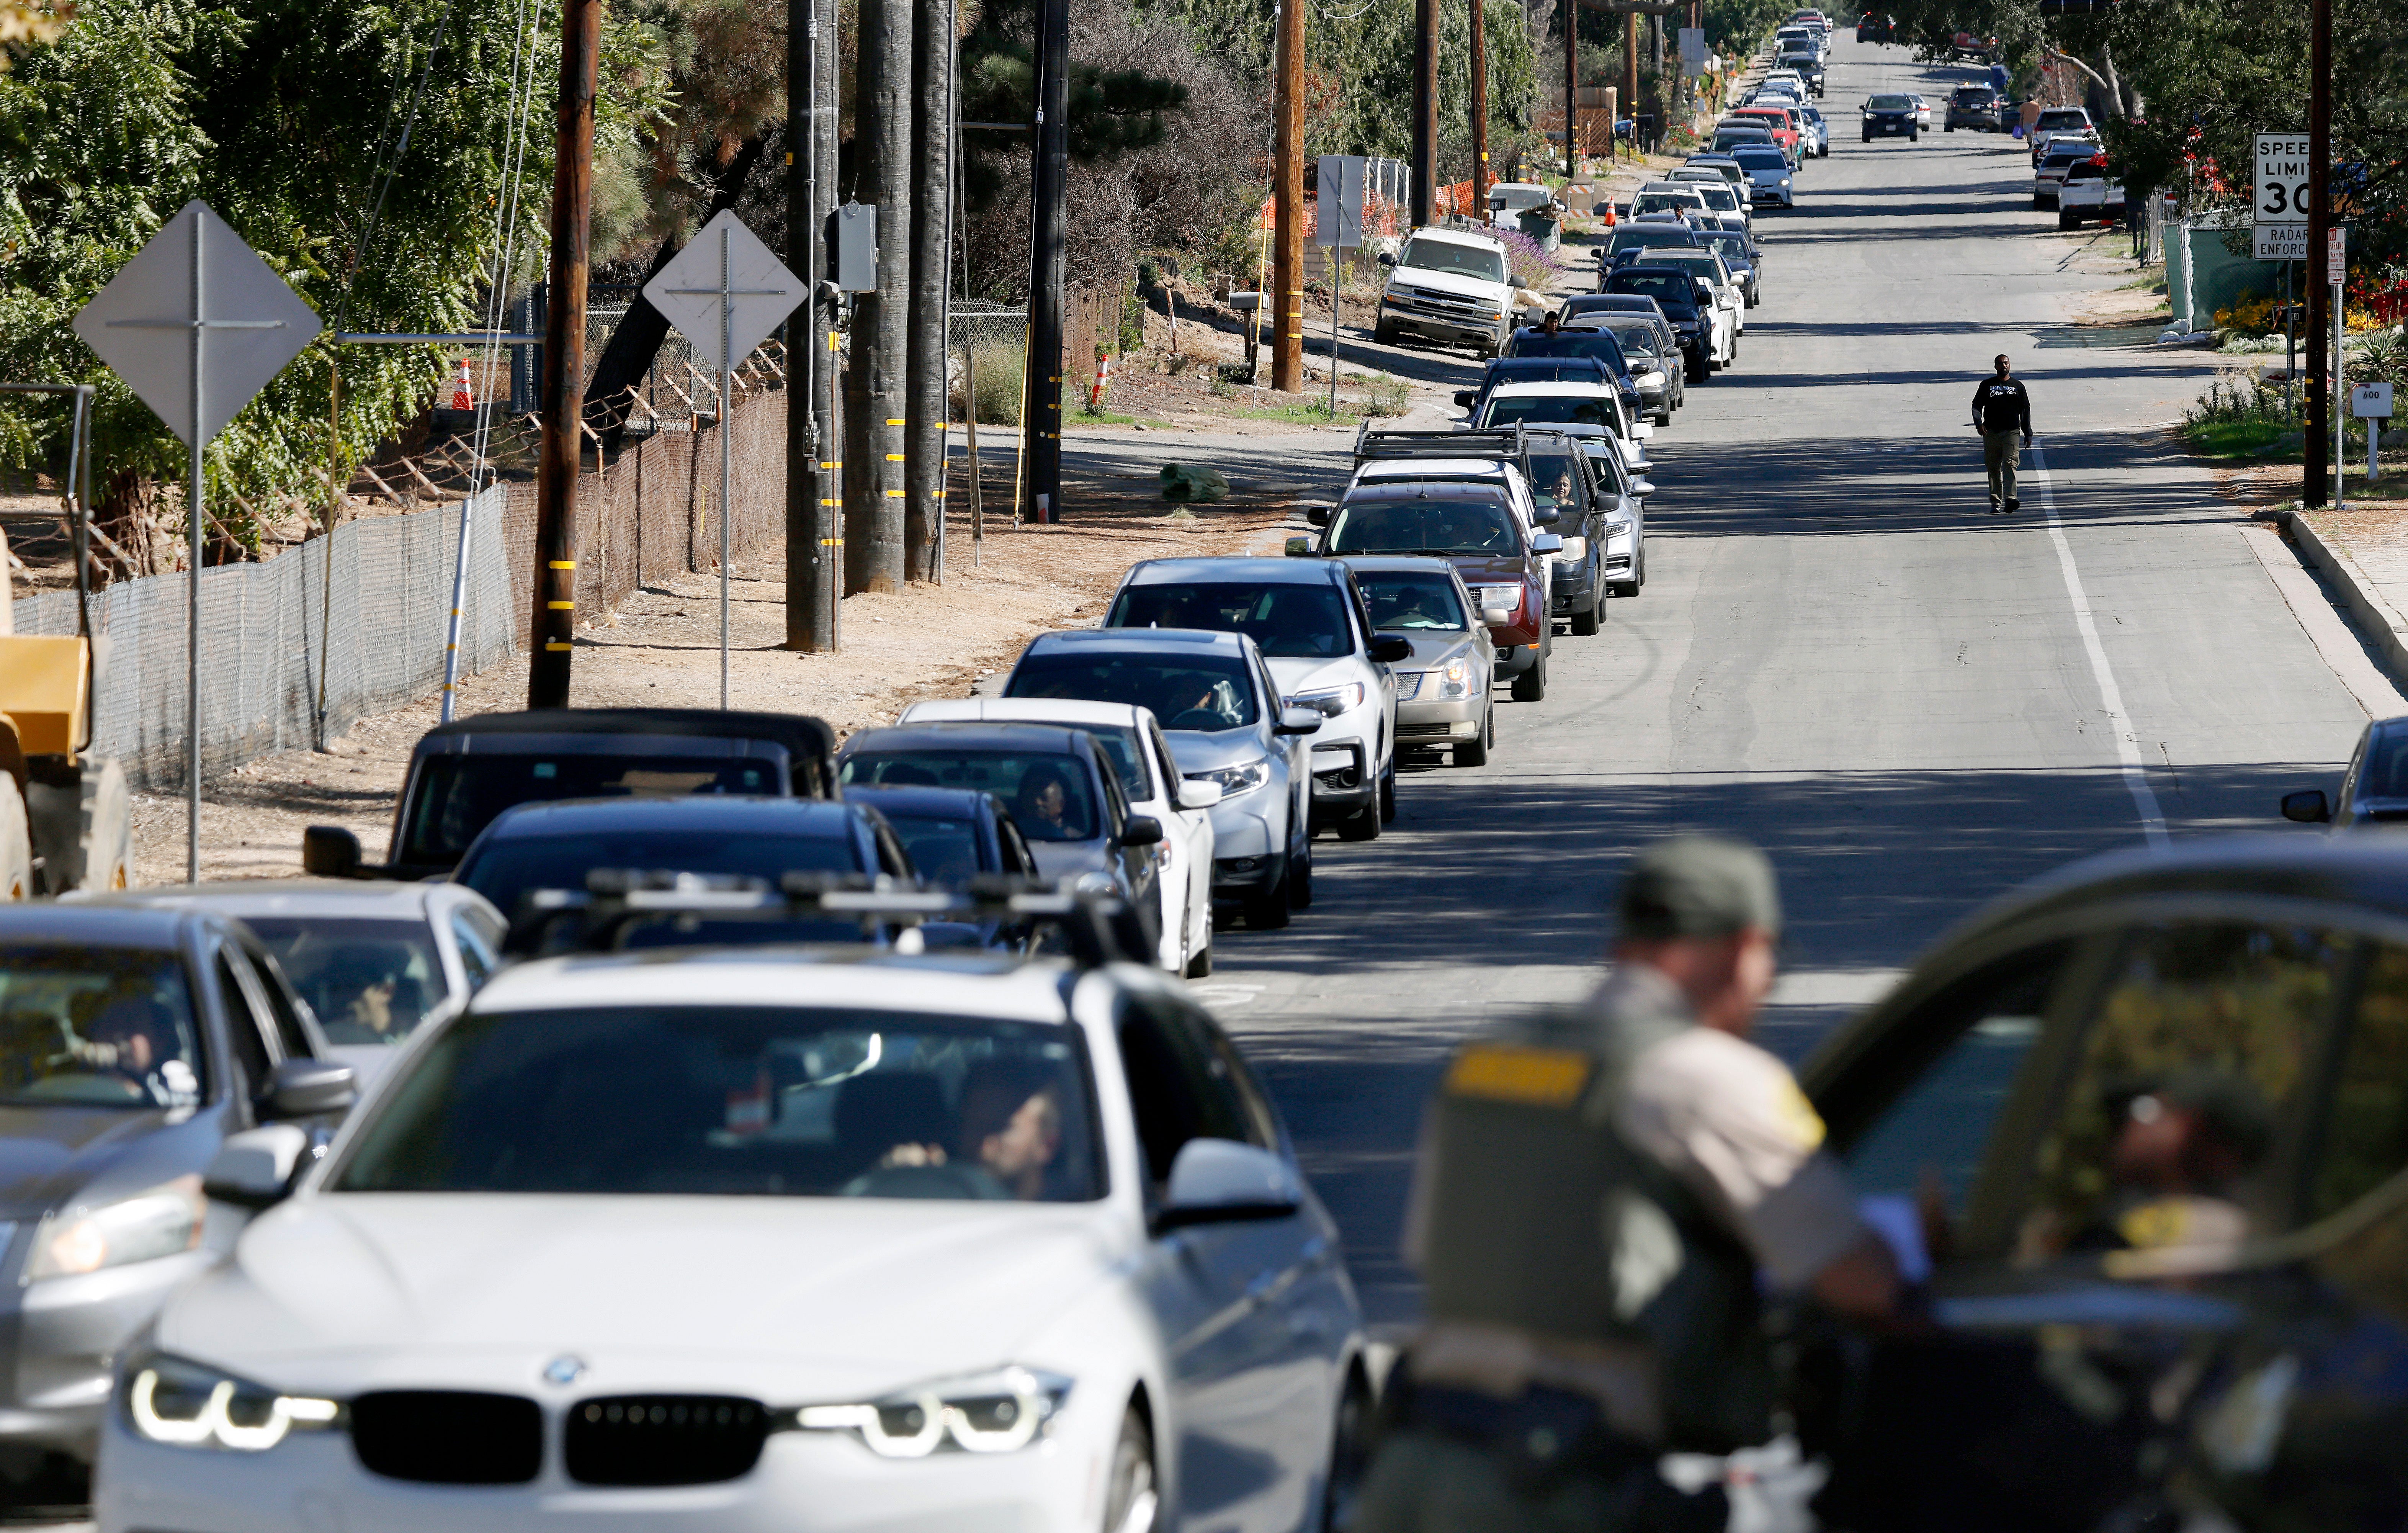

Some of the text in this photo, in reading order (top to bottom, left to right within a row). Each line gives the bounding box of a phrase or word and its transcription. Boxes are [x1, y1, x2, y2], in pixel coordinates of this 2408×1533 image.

[2259, 142, 2308, 155] SPEE
[2266, 163, 2309, 175] LIMI
[2271, 229, 2308, 241] RADAR
[2329, 231, 2335, 240] NO
[2261, 244, 2308, 254] ENFORC
[2329, 242, 2344, 250] PARKING
